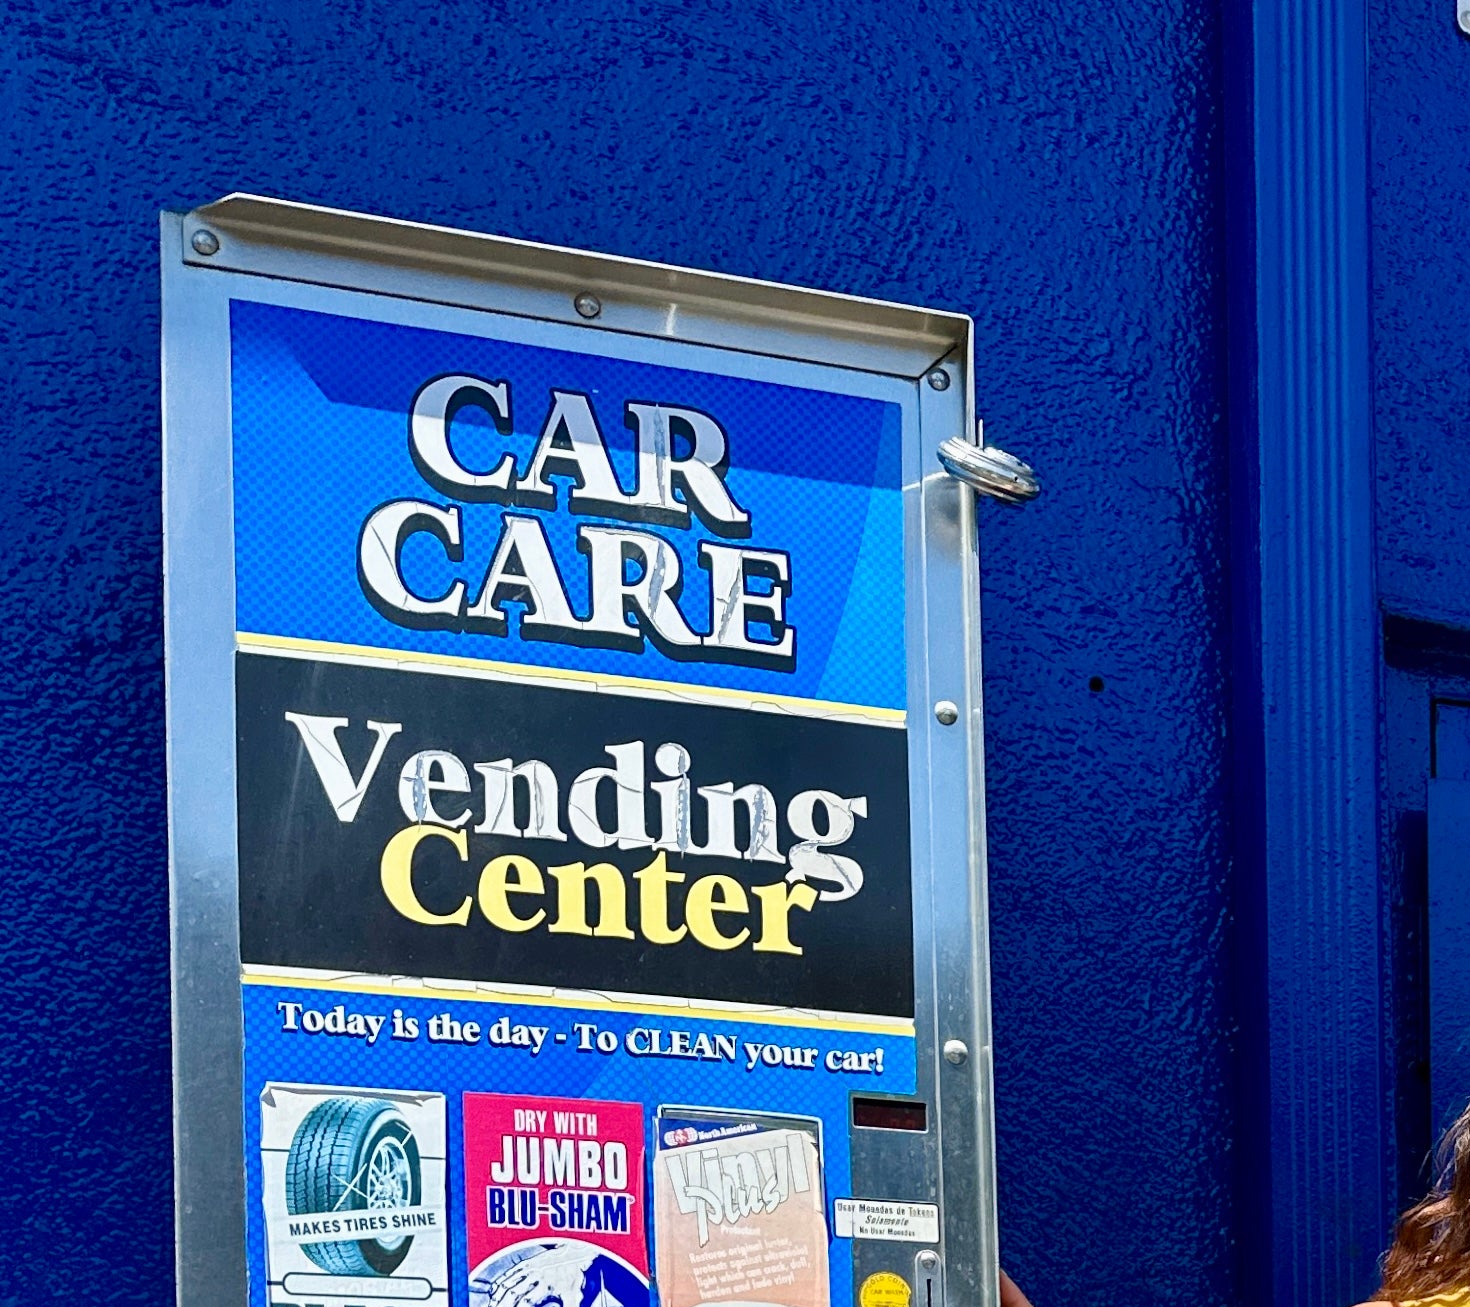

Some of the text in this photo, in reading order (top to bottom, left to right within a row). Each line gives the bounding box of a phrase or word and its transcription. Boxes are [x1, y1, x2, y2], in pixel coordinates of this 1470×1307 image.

[410, 374, 751, 530] CAR
[358, 500, 796, 662] CARE
[285, 711, 868, 903] Vending
[380, 824, 818, 957] Center
[276, 1002, 386, 1044] Today
[391, 1008, 420, 1040] is
[427, 1013, 482, 1044] the
[488, 1017, 550, 1055] day
[573, 1022, 619, 1053] To
[625, 1027, 738, 1062] CLEAN
[743, 1041, 819, 1070] your
[824, 1047, 885, 1073] car!
[490, 1135, 628, 1190] JUMBO
[513, 1108, 598, 1136] DRY WITH
[664, 1132, 811, 1215] Vinyl
[288, 1212, 437, 1236] MAKES TIRES SHINE
